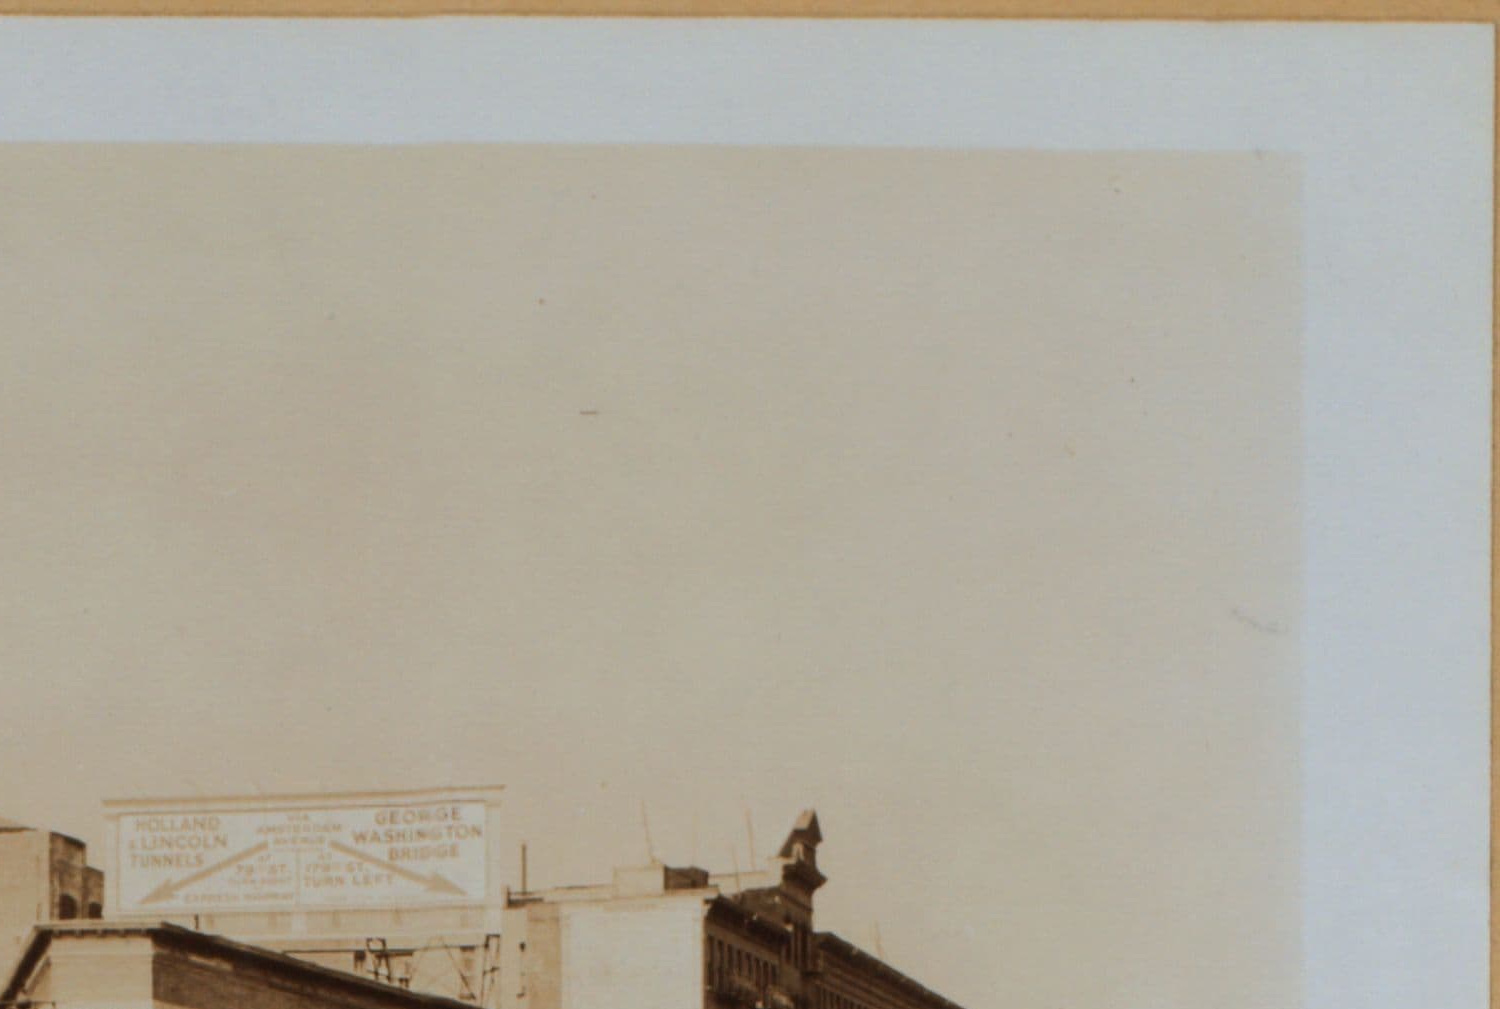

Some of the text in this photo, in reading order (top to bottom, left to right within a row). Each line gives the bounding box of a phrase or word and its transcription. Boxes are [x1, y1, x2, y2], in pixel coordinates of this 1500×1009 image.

[135, 816, 221, 832] HOLLAND
[374, 807, 462, 825] GEORGE
[140, 833, 228, 850] LINCOLN
[352, 825, 484, 845] WASHINGTON
[129, 853, 205, 868] TUNNELS
[387, 843, 461, 861] BRIDGE
